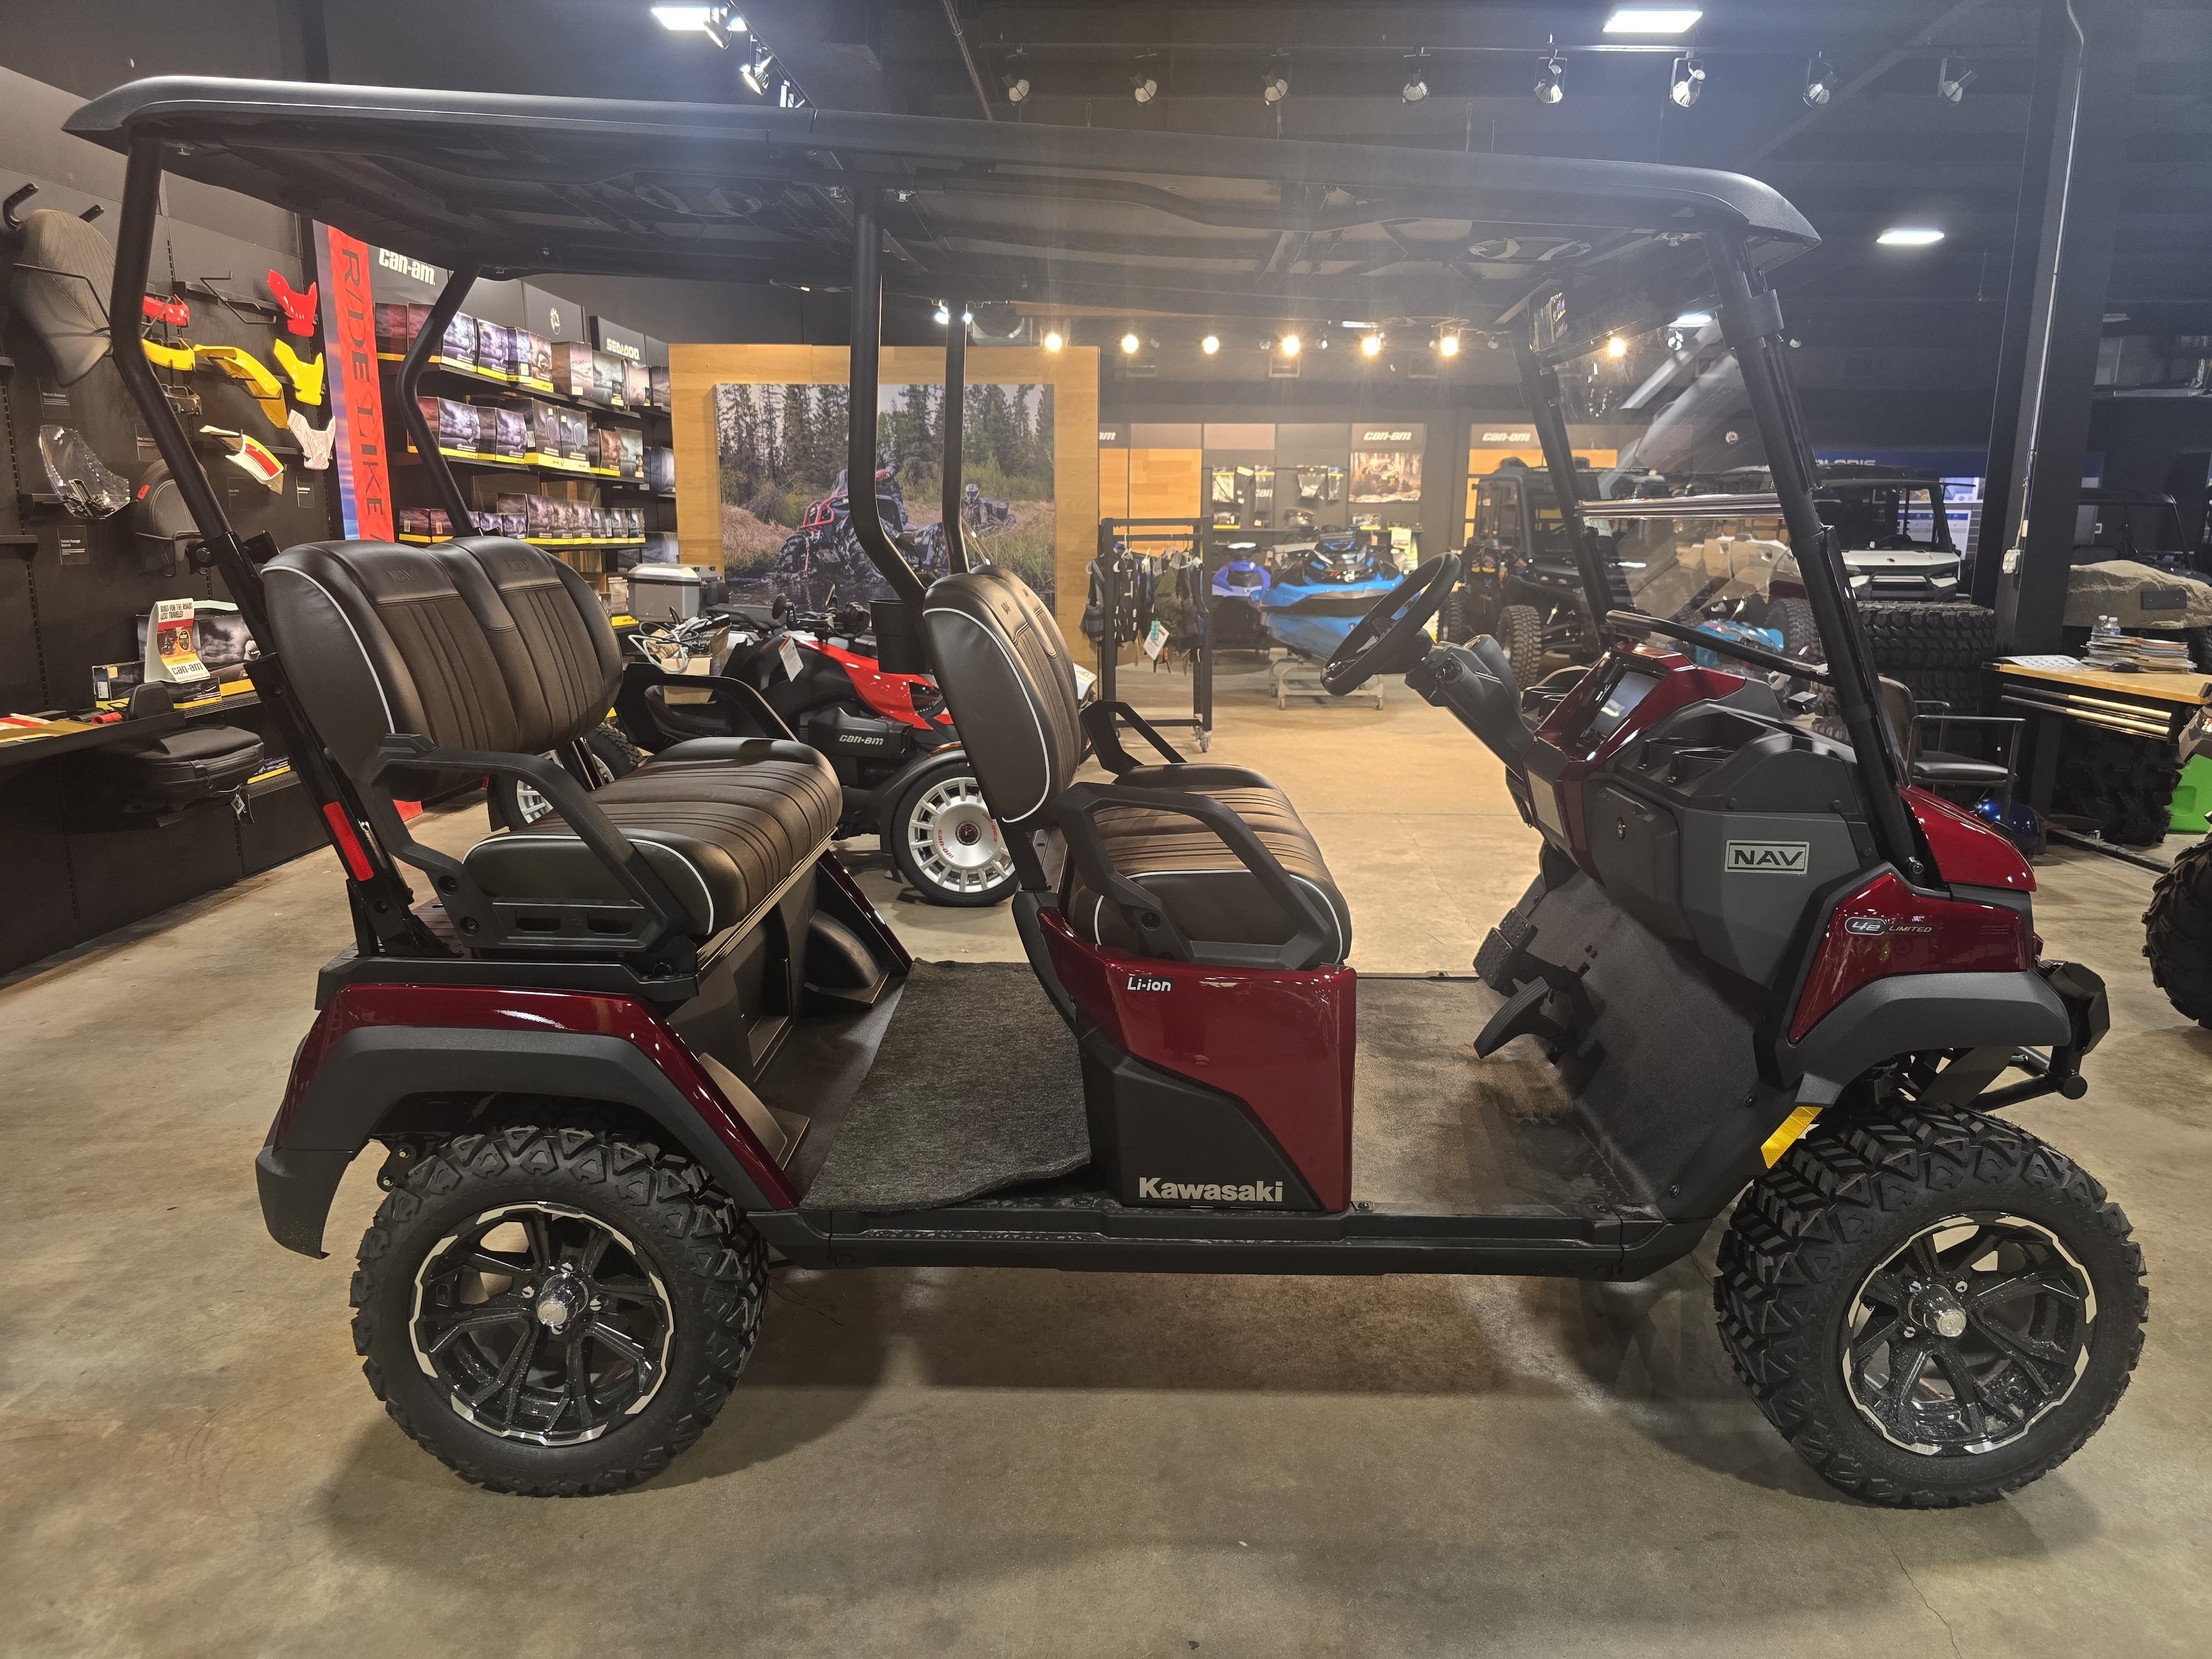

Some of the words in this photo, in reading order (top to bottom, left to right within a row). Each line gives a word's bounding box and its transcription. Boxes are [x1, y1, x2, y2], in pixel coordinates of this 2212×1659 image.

[379, 248, 435, 285] can-am
[1363, 431, 1412, 441] can-am
[1482, 432, 1531, 441] can-am
[356, 399, 384, 515] LIKE
[388, 568, 415, 583] NAV
[171, 662, 204, 675] can-am
[839, 734, 884, 745] can-am
[938, 829, 954, 859] can-am
[1734, 850, 1803, 866] NAV
[1851, 921, 1881, 931] 4e
[1127, 977, 1171, 992] Li-ion
[1139, 1177, 1283, 1202] Kawasaki
